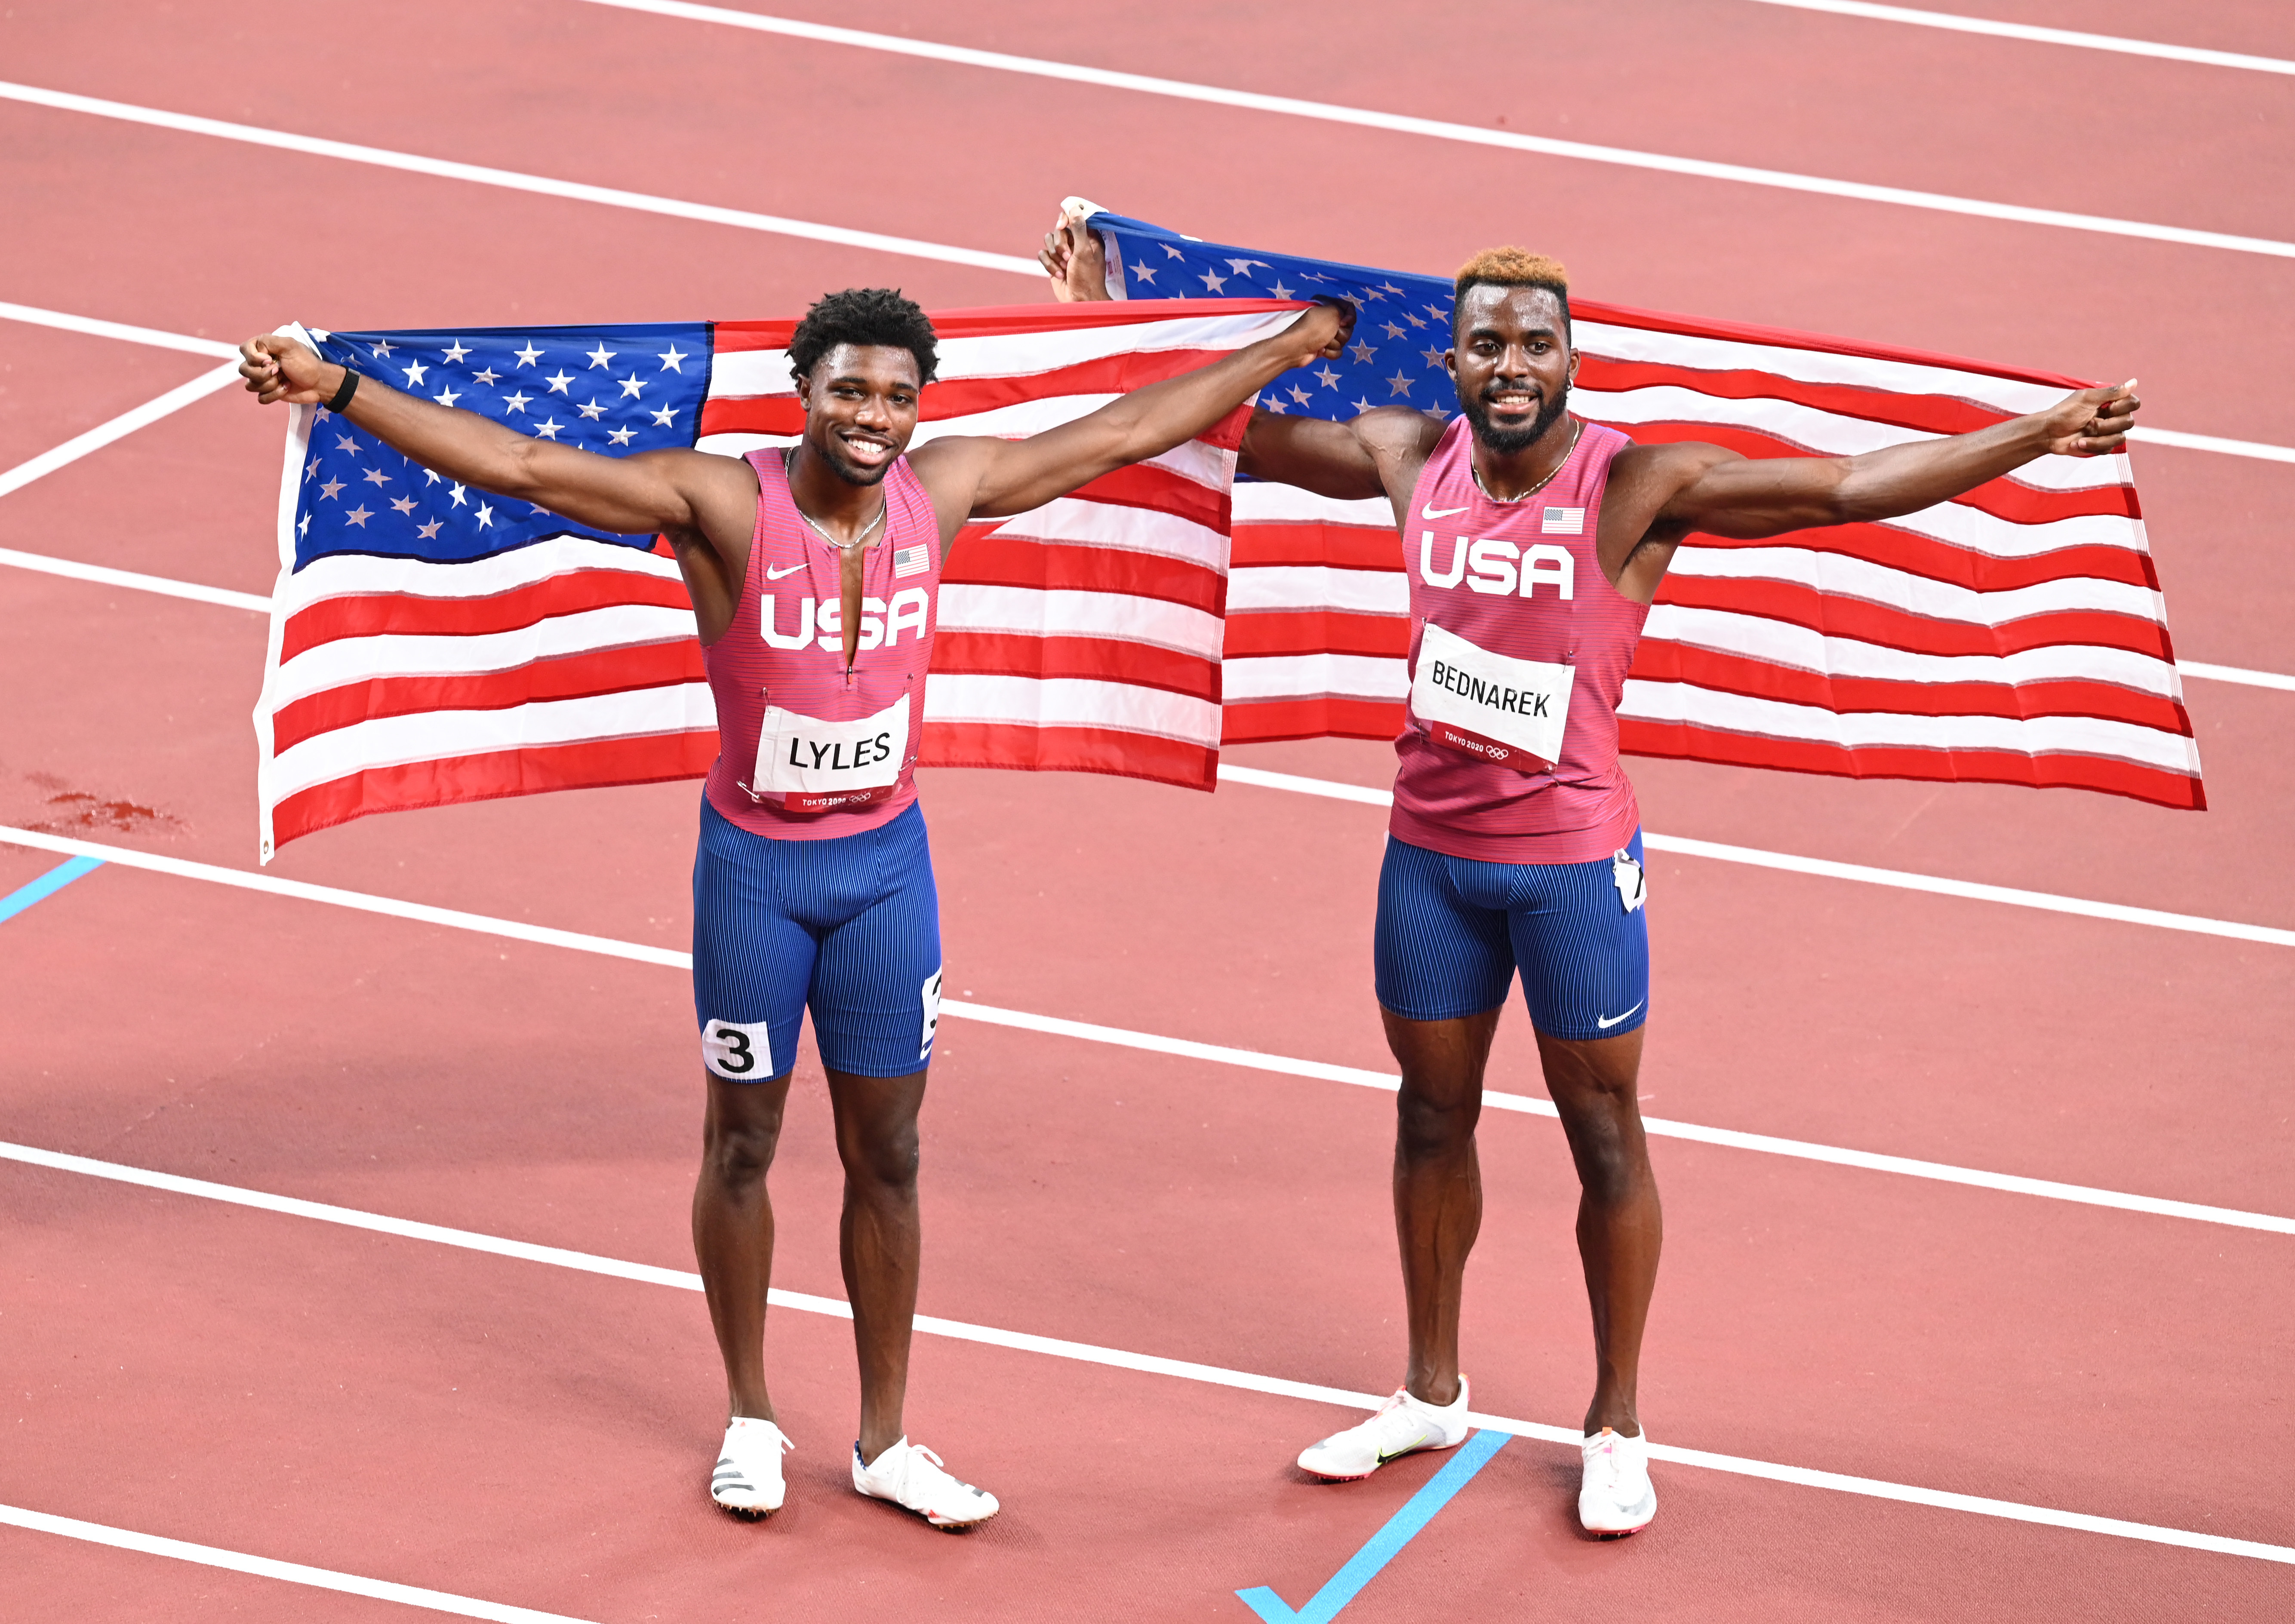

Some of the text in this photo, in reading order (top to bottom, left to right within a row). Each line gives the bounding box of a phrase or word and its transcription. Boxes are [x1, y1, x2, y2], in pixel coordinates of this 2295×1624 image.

[1420, 531, 1575, 600] USA
[760, 586, 929, 652] USA
[1432, 660, 1551, 718] BEDNAREK
[789, 732, 890, 771] LYLES
[1445, 731, 1484, 752] TOKYO 2020
[802, 798, 827, 806] TOKYO
[716, 1028, 755, 1074] 3
